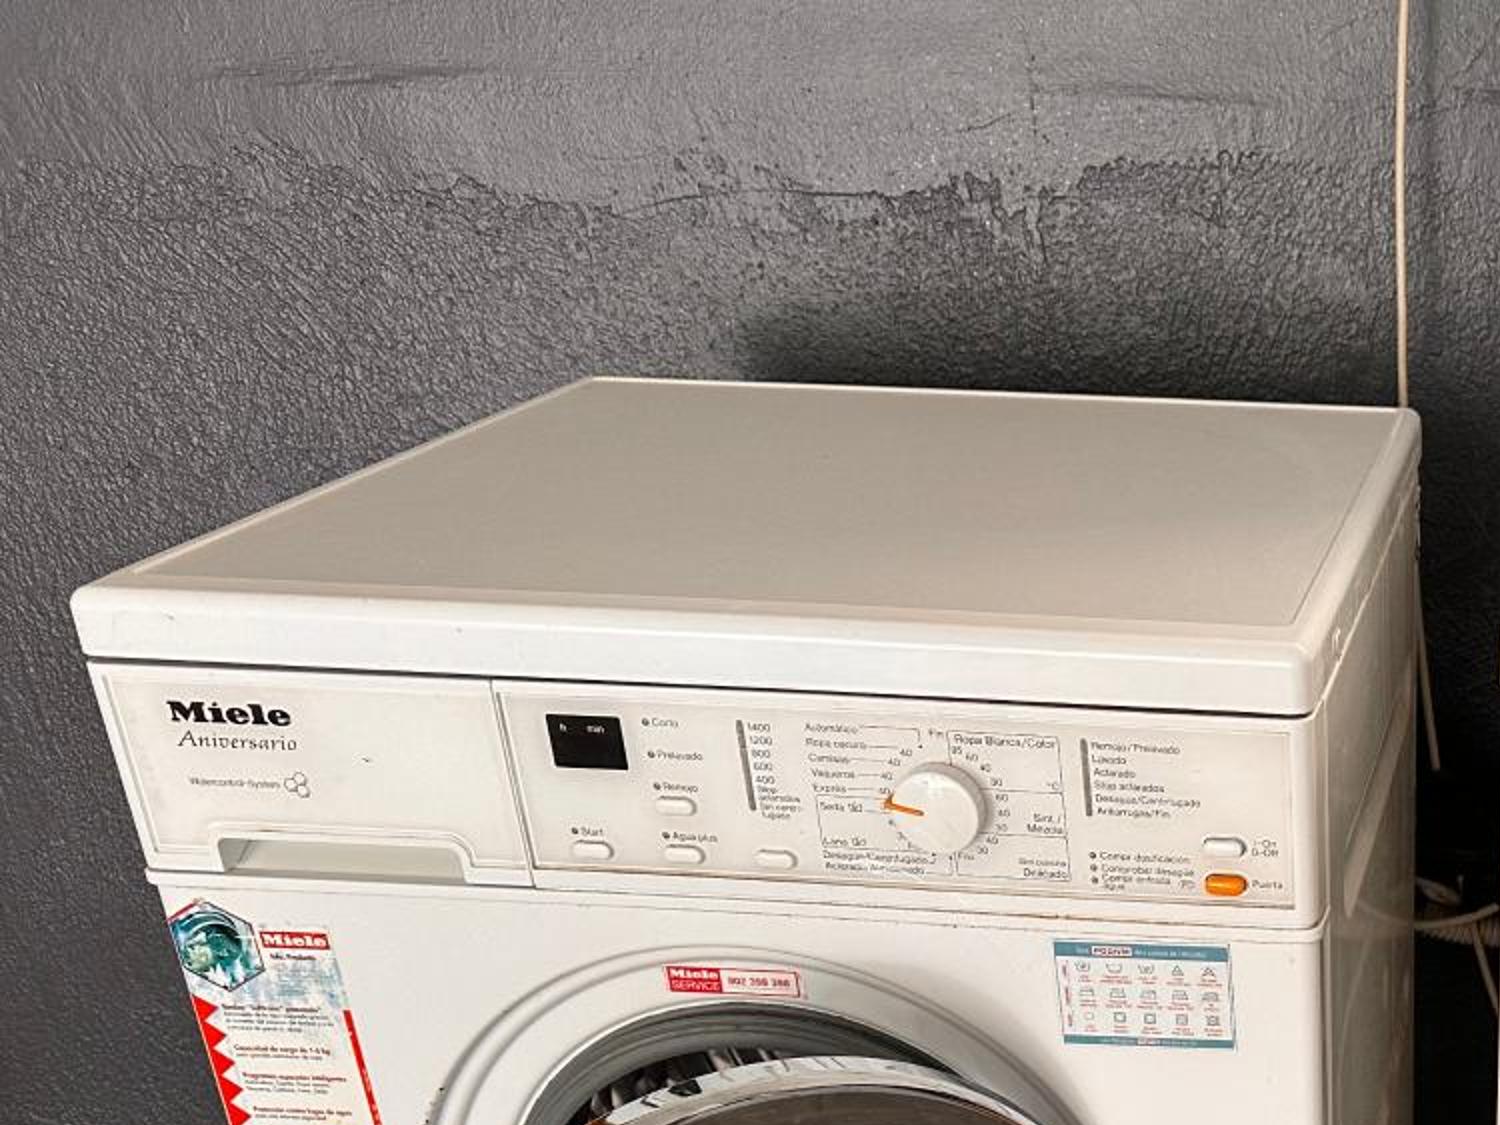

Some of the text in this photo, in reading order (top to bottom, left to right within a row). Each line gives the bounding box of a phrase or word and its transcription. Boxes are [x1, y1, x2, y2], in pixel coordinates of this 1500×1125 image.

[166, 700, 292, 726] Miele
[747, 723, 770, 732] 1400
[177, 729, 297, 751] Aniversario
[750, 736, 772, 746] 1200
[953, 735, 982, 745] Ropa
[1092, 755, 1126, 764] Lavado
[263, 933, 326, 947] Miele
[670, 969, 718, 979] Miele
